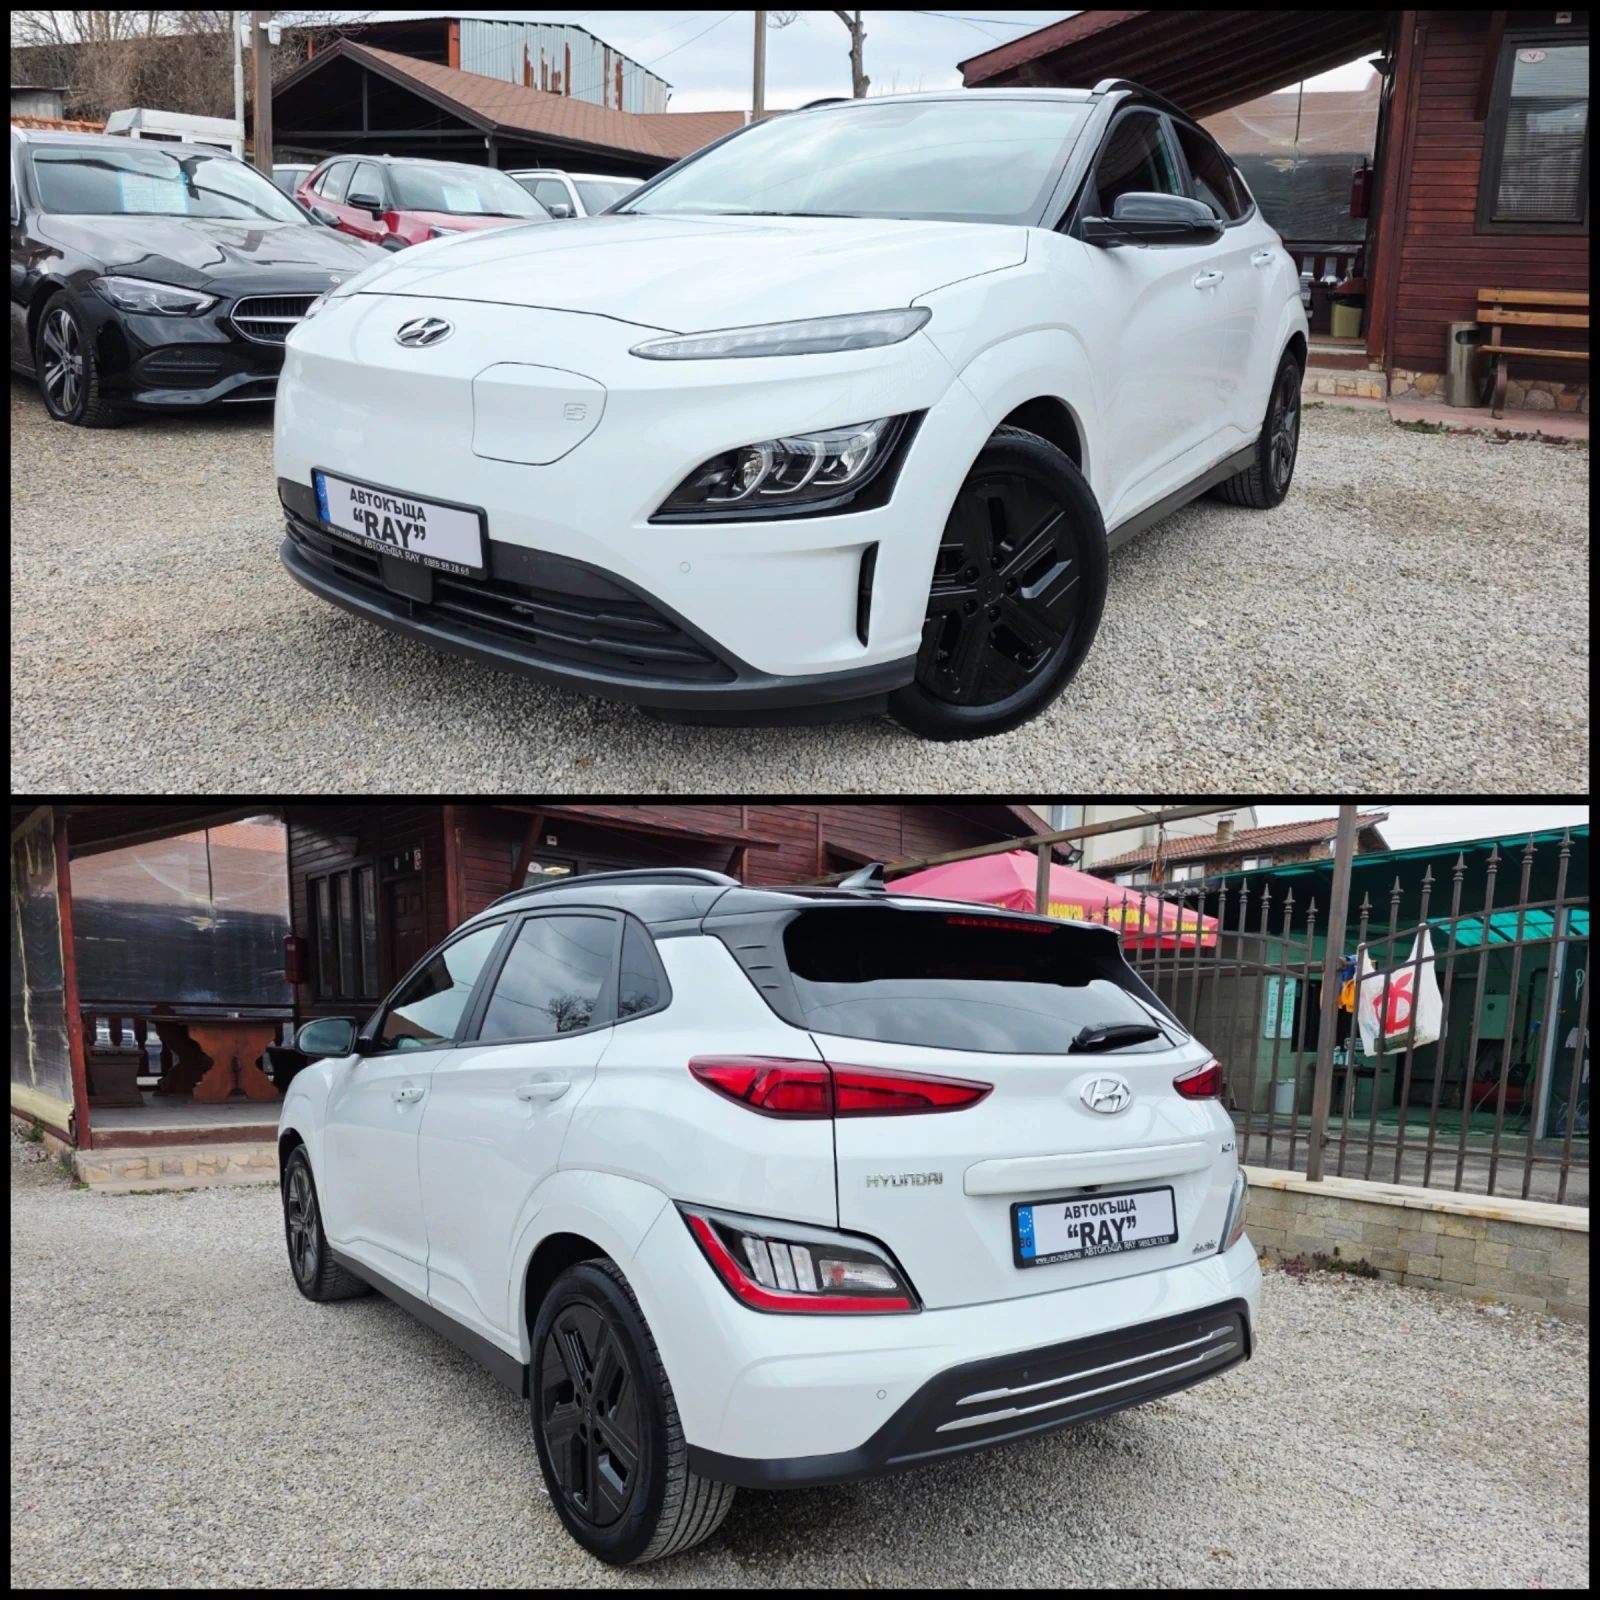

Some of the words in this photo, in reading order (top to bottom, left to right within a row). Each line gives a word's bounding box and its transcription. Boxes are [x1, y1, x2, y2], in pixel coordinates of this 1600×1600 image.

[350, 488, 427, 522] АВТОКЪЩА
[353, 507, 427, 549] “RAY”
[405, 550, 420, 563] RAY
[866, 1172, 943, 1188] HYUNDAI
[1064, 1198, 1136, 1220] АВТОКЪЩА
[1067, 1215, 1137, 1248] “RAY”
[1124, 1240, 1136, 1250] RAY
